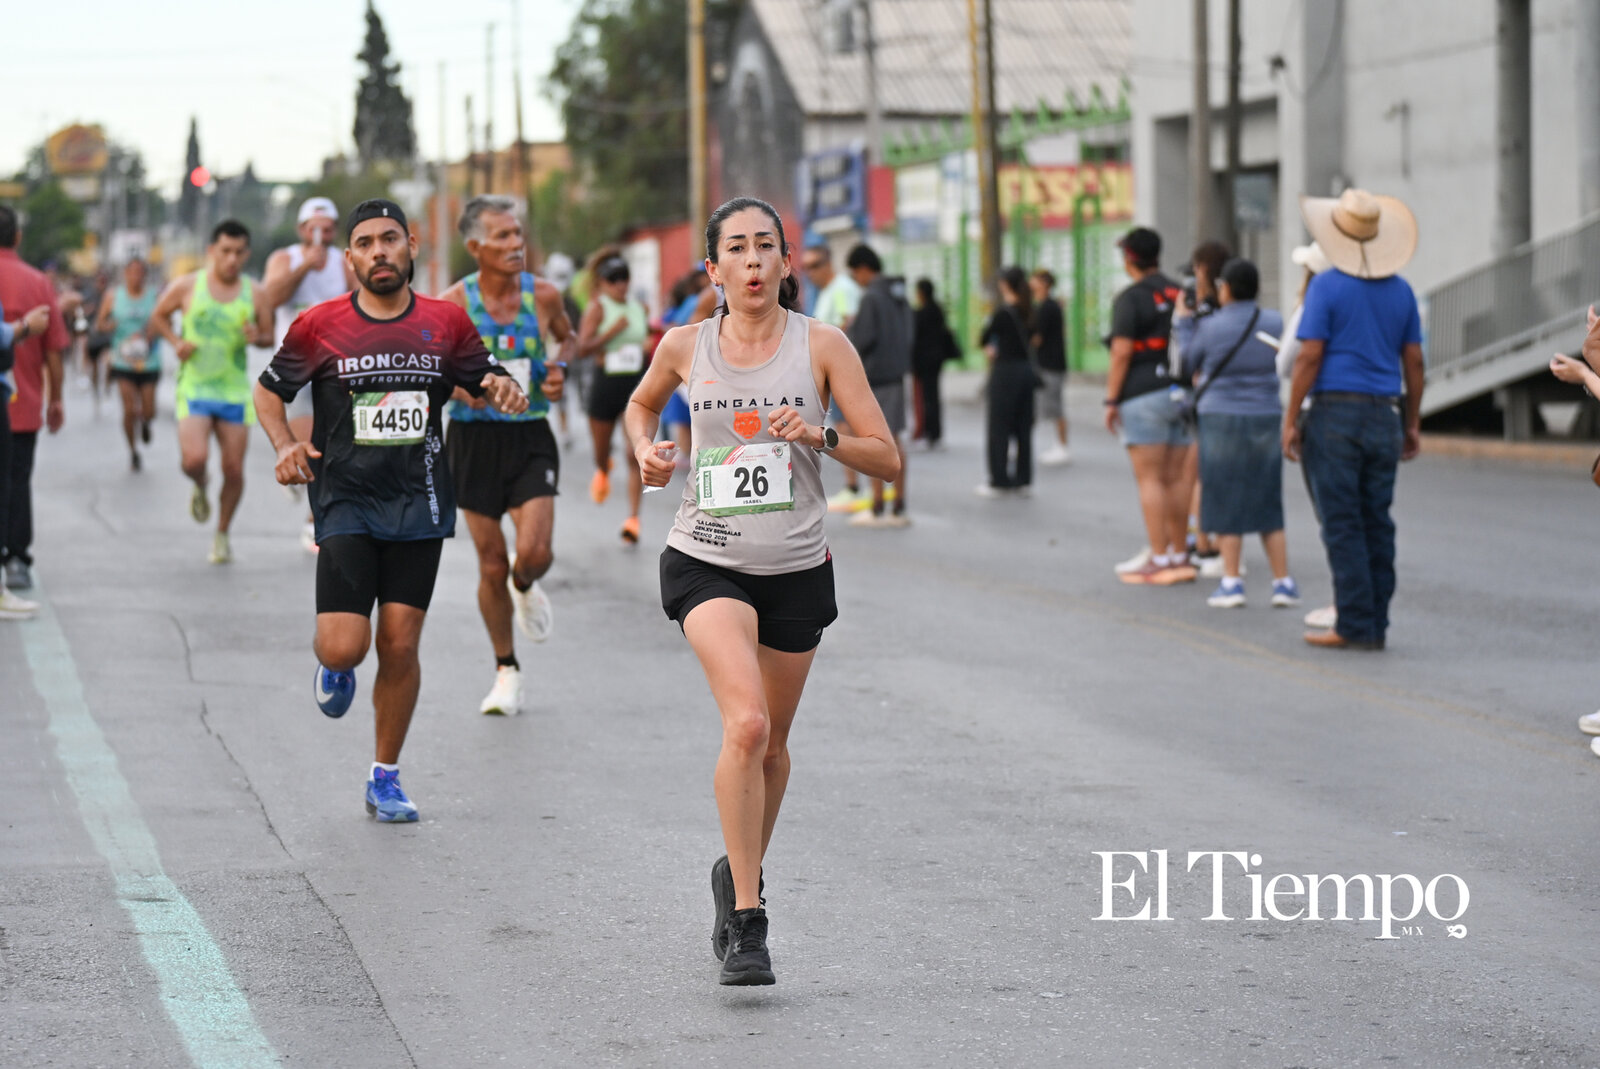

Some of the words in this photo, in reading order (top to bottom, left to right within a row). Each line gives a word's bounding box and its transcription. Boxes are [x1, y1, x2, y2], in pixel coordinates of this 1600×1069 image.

[338, 353, 442, 373] IRONCAST
[350, 378, 364, 386] DE
[371, 376, 433, 384] FRONTERA
[372, 407, 423, 433] 4450
[734, 465, 769, 498] 26
[692, 530, 713, 538] MEXICO
[714, 528, 742, 537] BENGALAS
